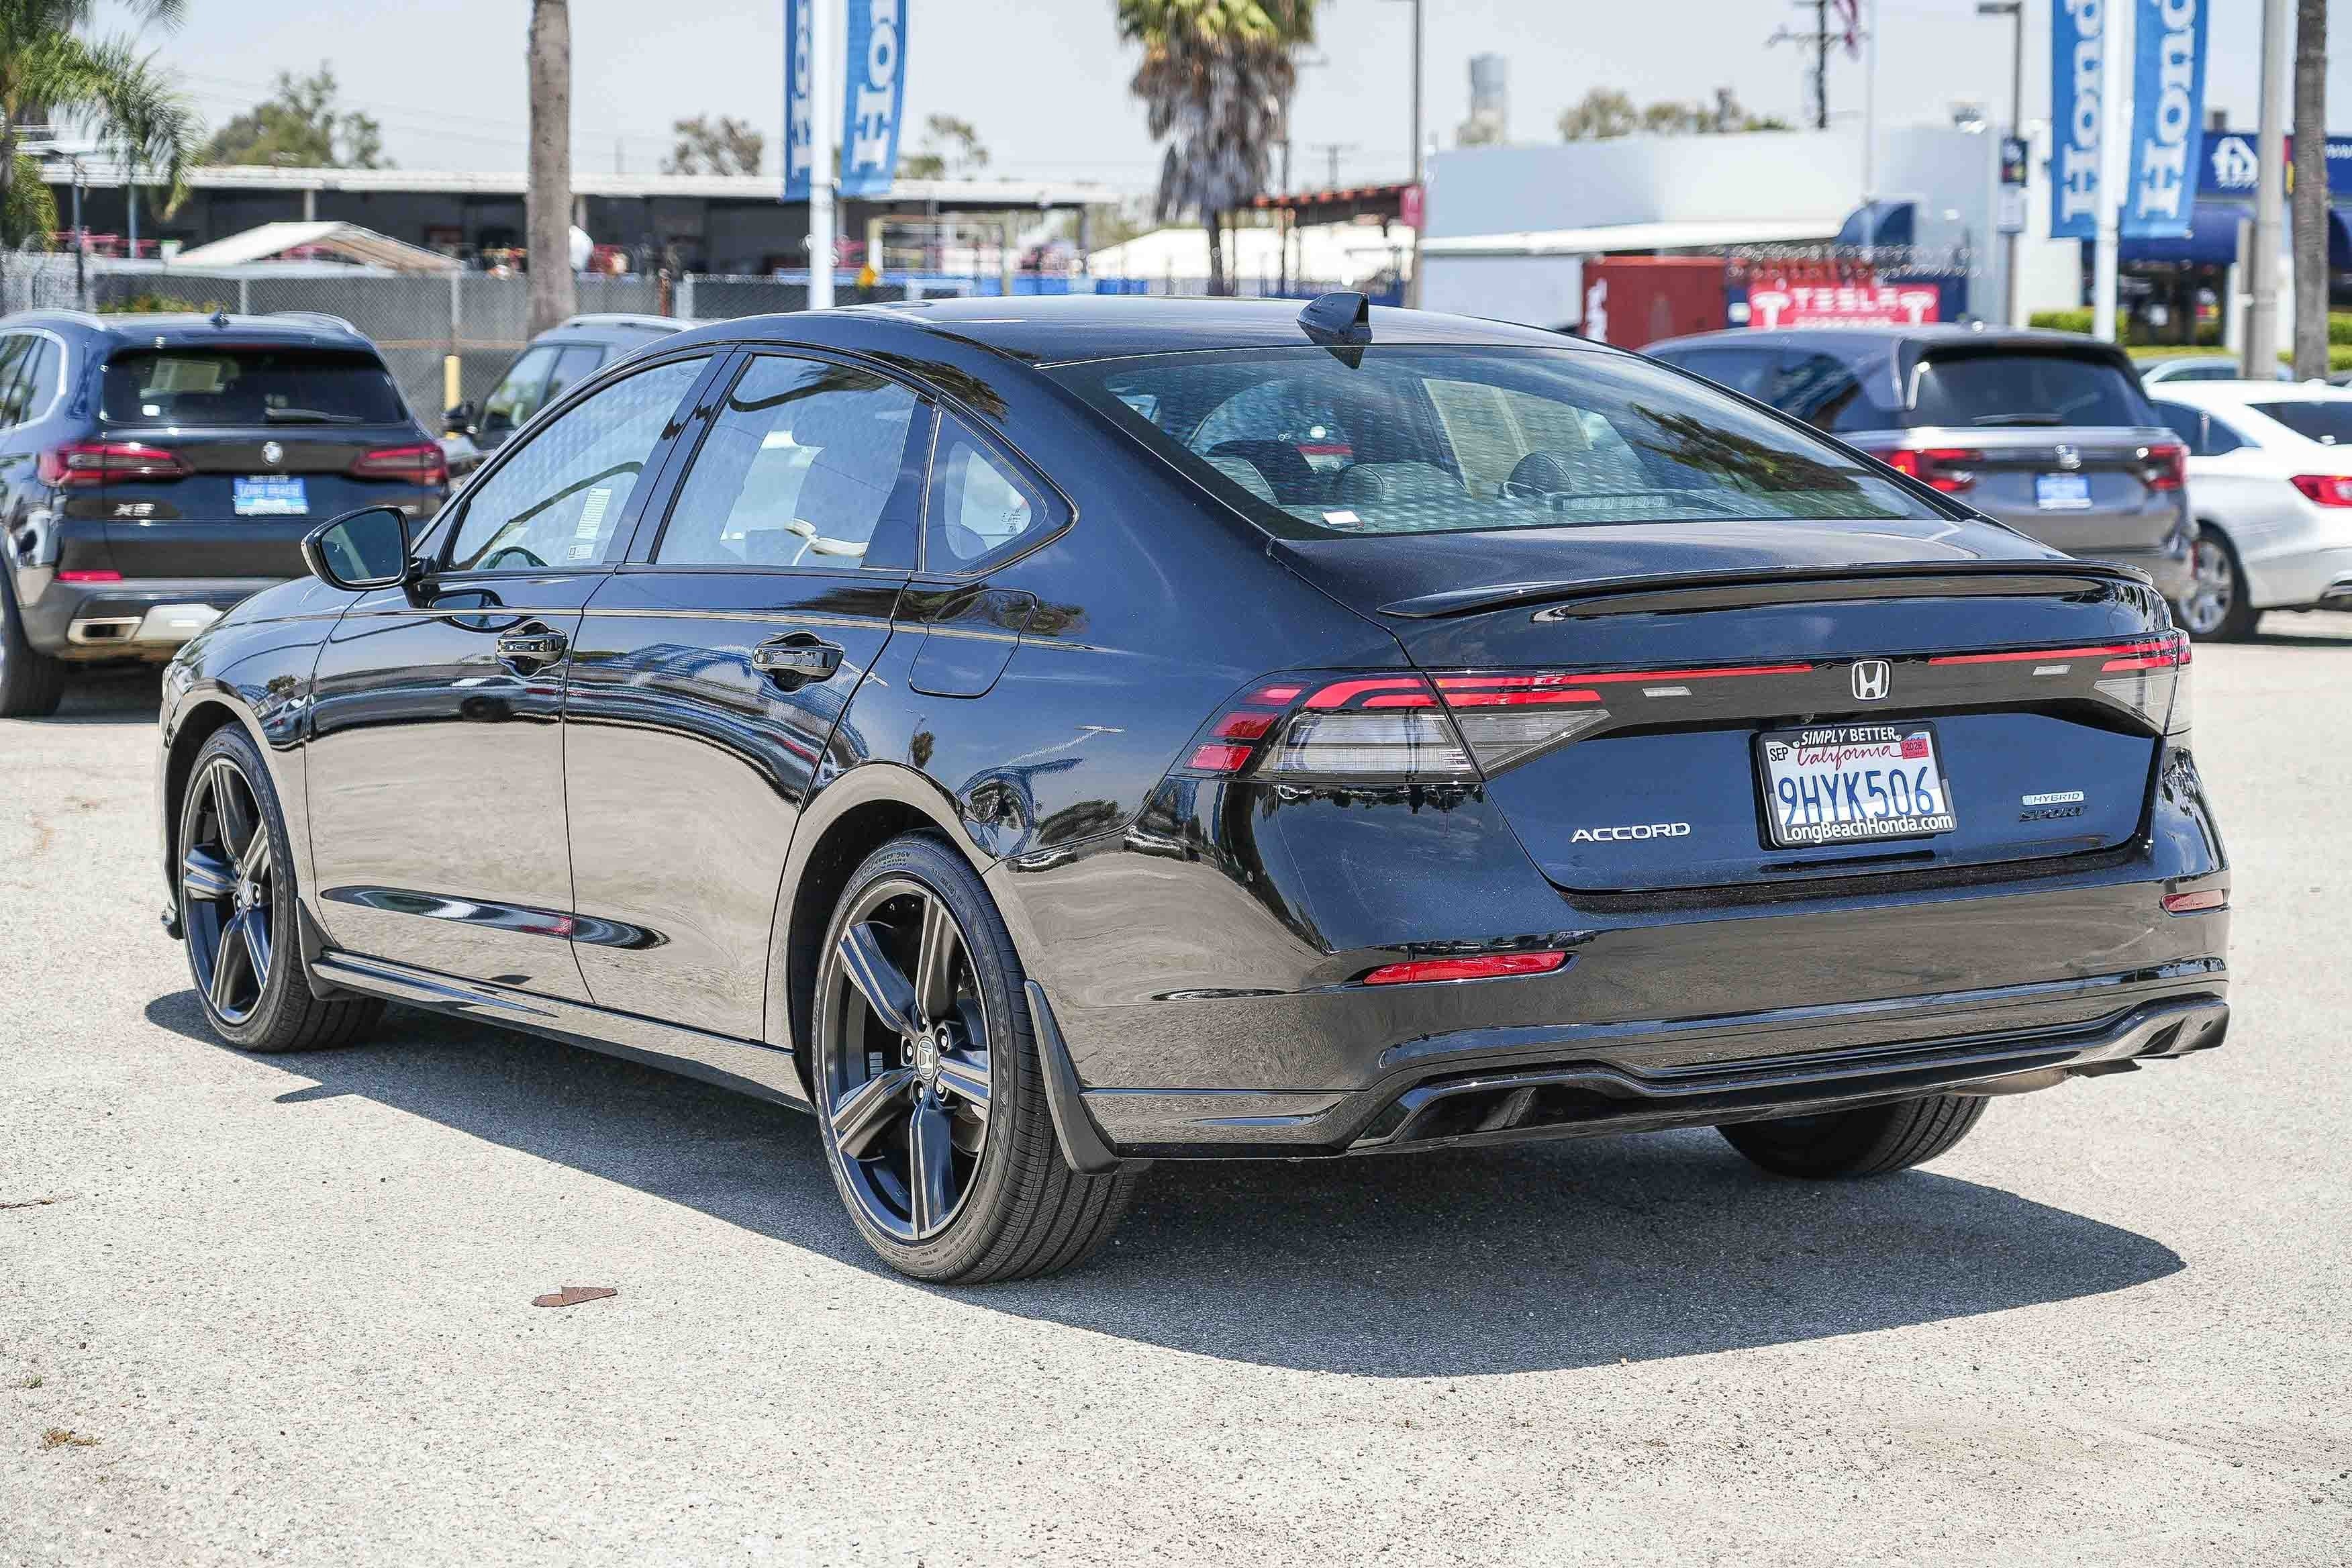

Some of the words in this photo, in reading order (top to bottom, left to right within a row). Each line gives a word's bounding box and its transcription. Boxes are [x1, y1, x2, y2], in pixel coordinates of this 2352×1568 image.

[1800, 728, 1847, 746] SIMPLY
[1849, 726, 1897, 742] BETTER
[1769, 746, 1789, 763] SEP
[1797, 744, 1902, 771] California
[1778, 766, 1934, 827] 9HYK506
[2033, 793, 2080, 803] HYBRID
[1569, 822, 1692, 843] ACCORD
[1782, 814, 1953, 844] LongBeachHonda.com
